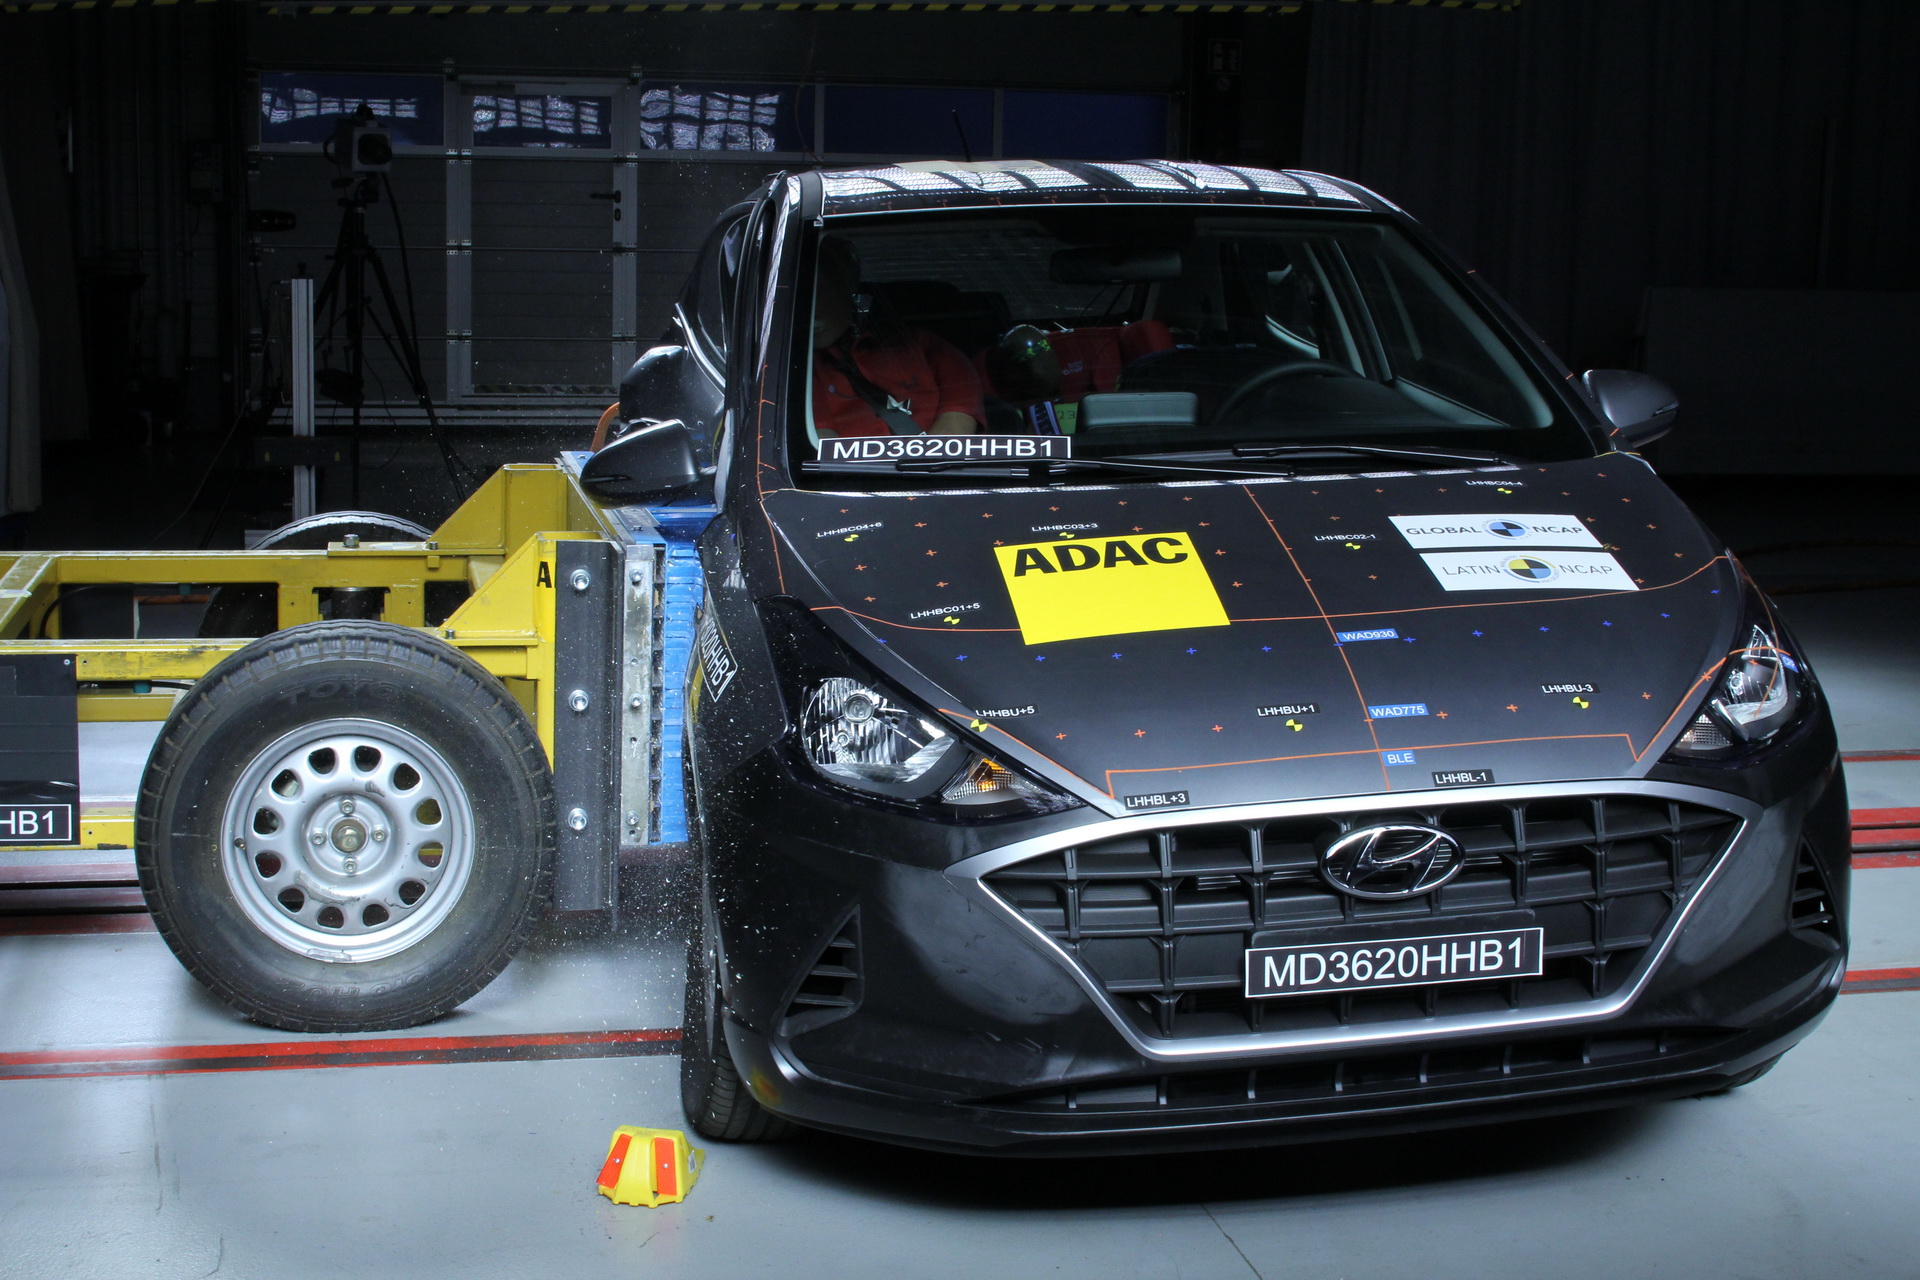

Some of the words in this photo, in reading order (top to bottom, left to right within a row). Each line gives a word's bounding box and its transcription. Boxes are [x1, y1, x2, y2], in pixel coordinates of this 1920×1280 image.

[832, 438, 1053, 460] MD3620HHB1
[816, 522, 883, 538] LHHBC04+6
[1031, 522, 1099, 532] LHHBC03+3
[1405, 525, 1482, 536] GLOBAL
[1532, 525, 1583, 535] NCAP
[1014, 537, 1189, 577] ADAC
[1442, 564, 1501, 576] LATIN
[1559, 564, 1613, 575] NCAP
[910, 602, 981, 619] LHHBC01+5
[1342, 629, 1395, 641] WAD930
[1542, 683, 1594, 694] LHHBU-3
[975, 704, 1034, 718] LHHBU+5
[1256, 705, 1315, 717] LHHBU+1
[1371, 705, 1425, 717] WAD775
[1387, 753, 1414, 764] BLE
[1435, 771, 1487, 784] LHHBL-1
[1126, 793, 1187, 808] LHHBL+3
[1264, 936, 1521, 988] MD3620HHB1
